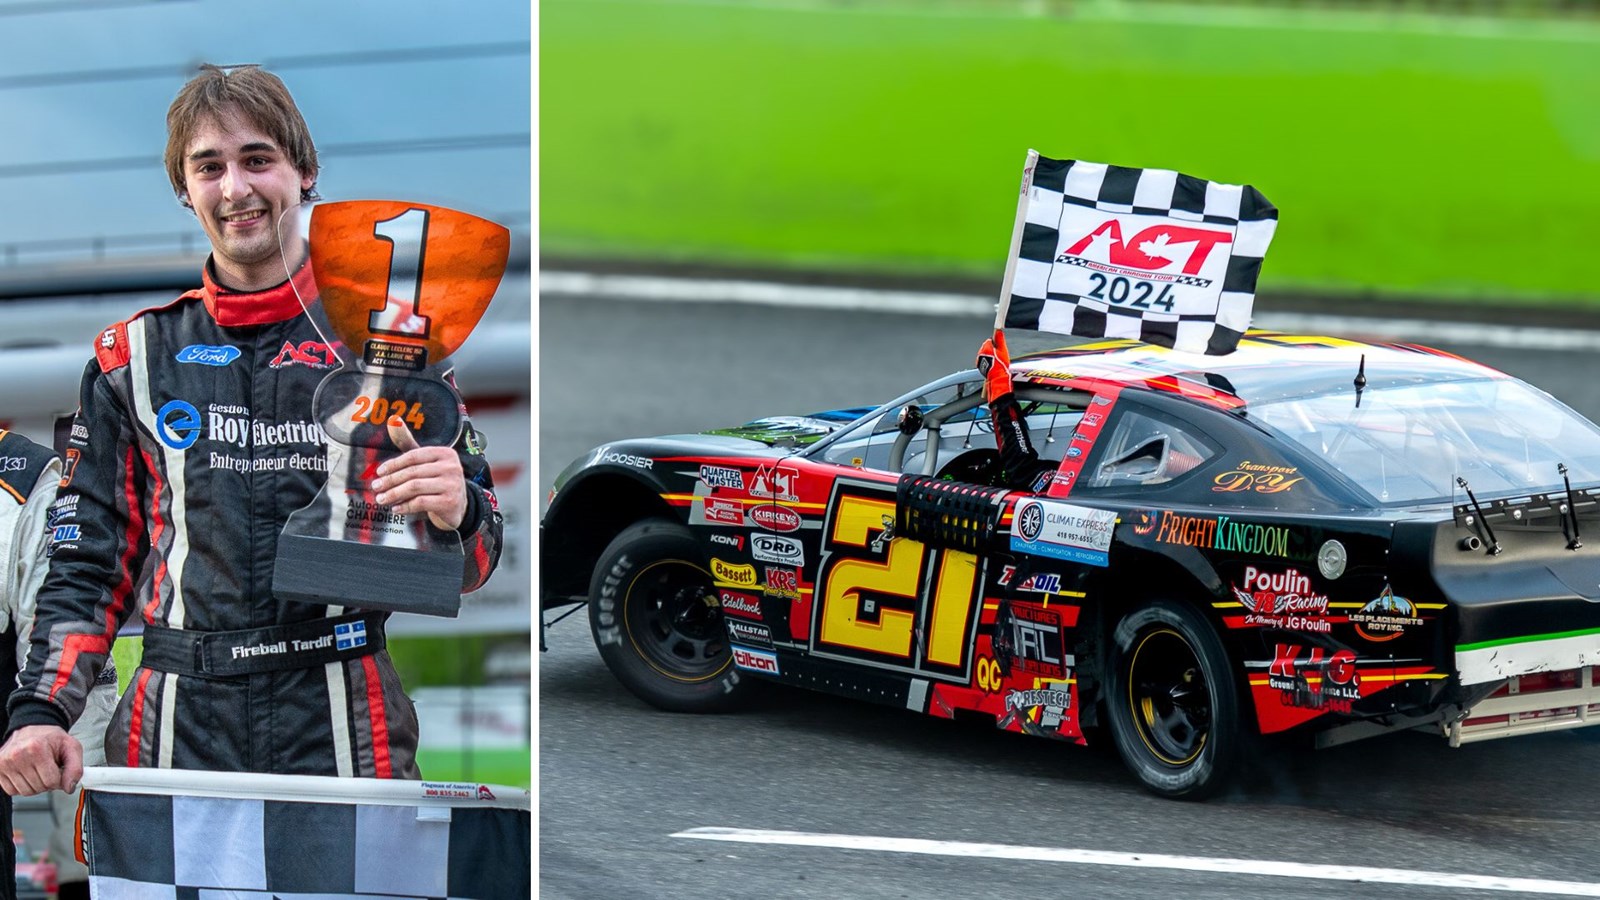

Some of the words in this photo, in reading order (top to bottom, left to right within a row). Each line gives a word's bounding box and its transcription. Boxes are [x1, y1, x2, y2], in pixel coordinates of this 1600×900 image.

[1064, 219, 1233, 276] ACT
[368, 207, 431, 339] 1
[1088, 262, 1118, 273] AMERICAN
[1119, 270, 1153, 279] CANADIAN
[1088, 273, 1175, 312] 2024
[187, 347, 229, 364] Ford
[271, 340, 344, 366] ACT
[371, 357, 383, 365] ACT
[208, 403, 250, 416] Gestion
[351, 395, 425, 430] 2024
[208, 411, 249, 448] Roy
[602, 451, 654, 470] HOOSIER
[1236, 460, 1298, 475] Transport
[701, 466, 741, 480] QUARTER
[708, 476, 743, 489] MASTER
[749, 463, 799, 495] ACT
[754, 510, 792, 521] KIRKEY
[1046, 512, 1075, 525] CLIMAT
[1076, 517, 1108, 532] EXPRESS
[710, 534, 739, 547] KONI
[760, 539, 795, 554] DRP
[1056, 531, 1067, 539] 418
[1068, 533, 1093, 543] 957-6555
[754, 553, 783, 563] Performance
[715, 561, 752, 583] Bassett
[766, 567, 797, 593] KRC
[820, 494, 979, 668] 21
[1244, 566, 1310, 594] Poulin
[722, 593, 762, 615] Edelbrock
[1254, 592, 1276, 613] 78
[1284, 592, 1328, 613] Racing
[1245, 615, 1254, 624] In
[1255, 615, 1276, 628] Memory
[1286, 616, 1300, 629] JG
[1301, 617, 1331, 632] Poulin
[1348, 614, 1364, 622] LES
[1365, 615, 1424, 626] PLACEMENTS
[1368, 623, 1386, 631] ROY
[735, 624, 769, 637] ALLSTAR
[232, 641, 287, 659] Fireball
[291, 634, 333, 652] Tardif
[734, 650, 776, 672] tilton
[977, 657, 1001, 692] QC
[1270, 679, 1295, 690] Ground
[1342, 687, 1361, 699] L.L.C.
[439, 789, 452, 797] 835
